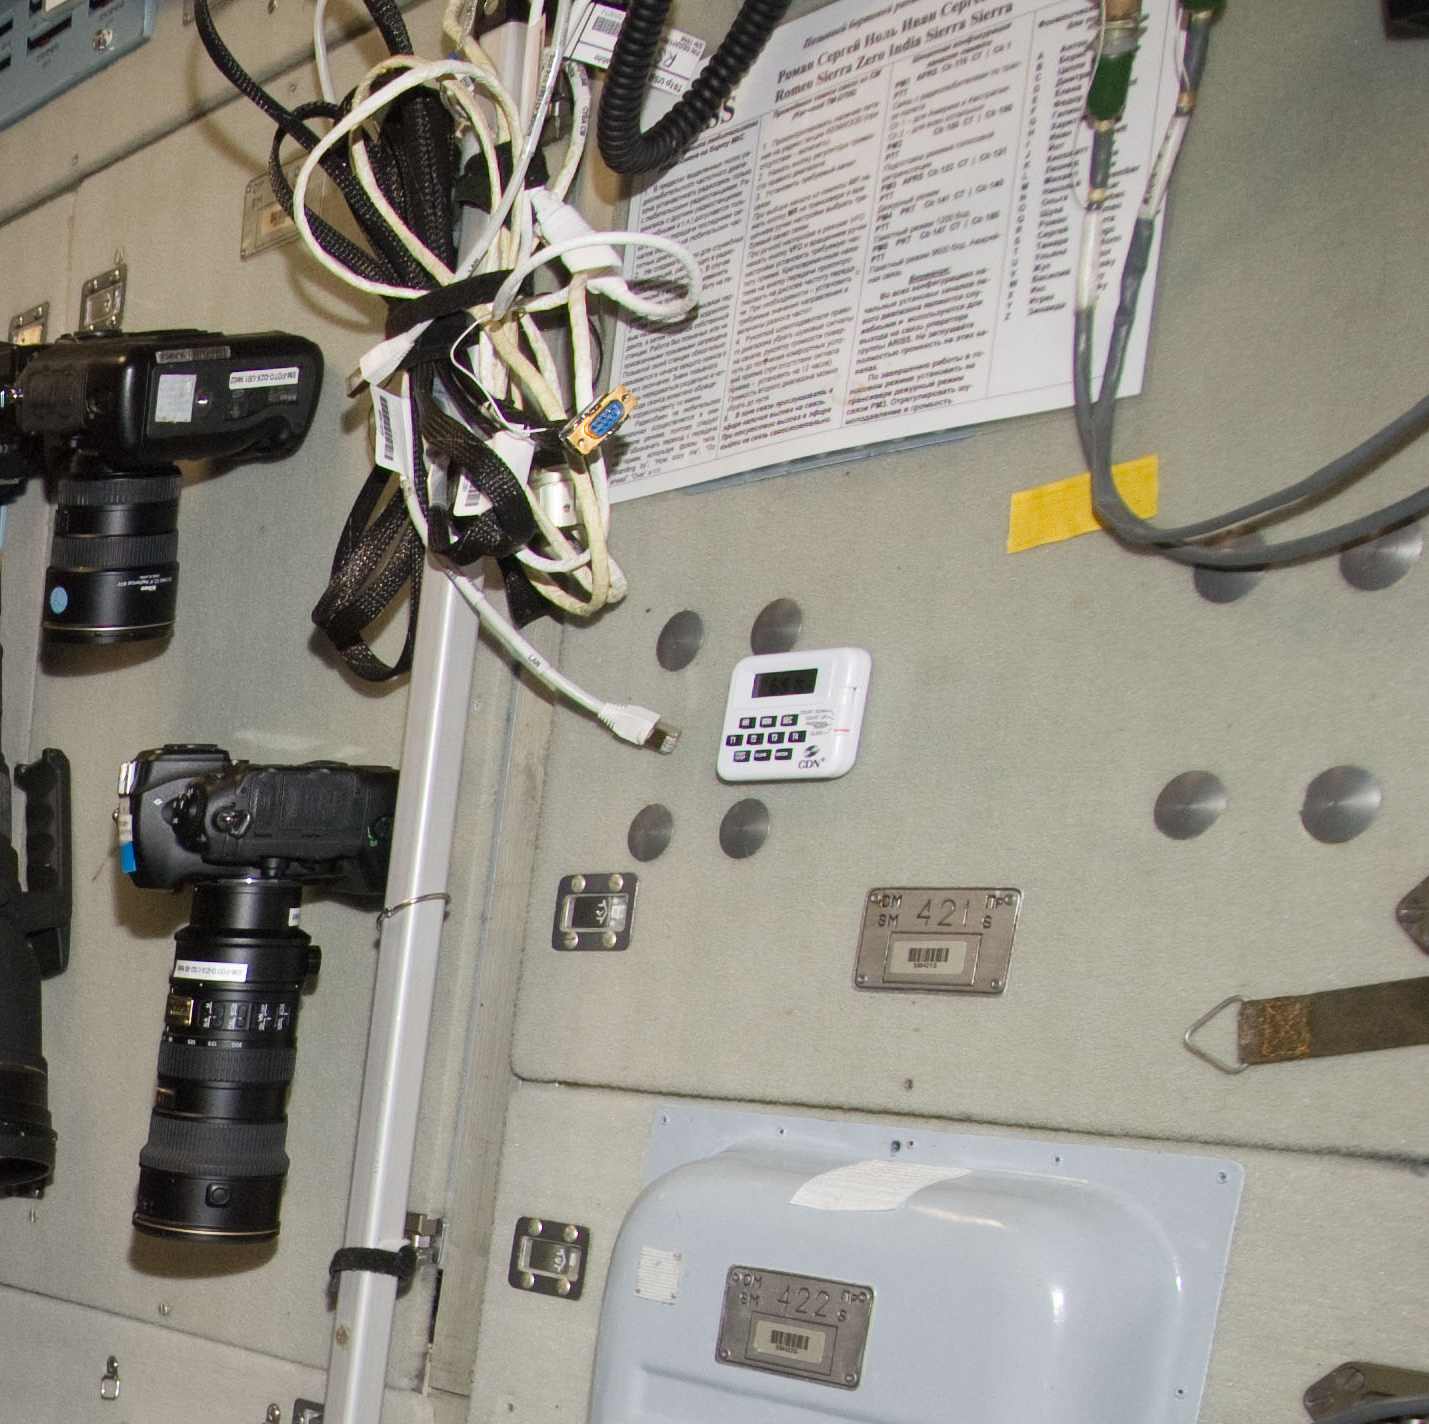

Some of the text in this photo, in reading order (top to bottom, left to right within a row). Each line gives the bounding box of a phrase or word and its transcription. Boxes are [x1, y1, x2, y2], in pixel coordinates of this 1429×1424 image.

[775, 80, 813, 103] Romeo
[816, 63, 853, 86] Sierra
[855, 50, 885, 71] Zero
[888, 37, 921, 58] India
[925, 18, 966, 42] Sierra
[970, 2, 1014, 27] Sierra
[778, 60, 814, 84] Роман
[817, 40, 861, 67] Сергей
[877, 913, 993, 929] SM S
[916, 899, 970, 929] 421
[740, 1292, 760, 1306] SM
[777, 1286, 830, 1317] 422
